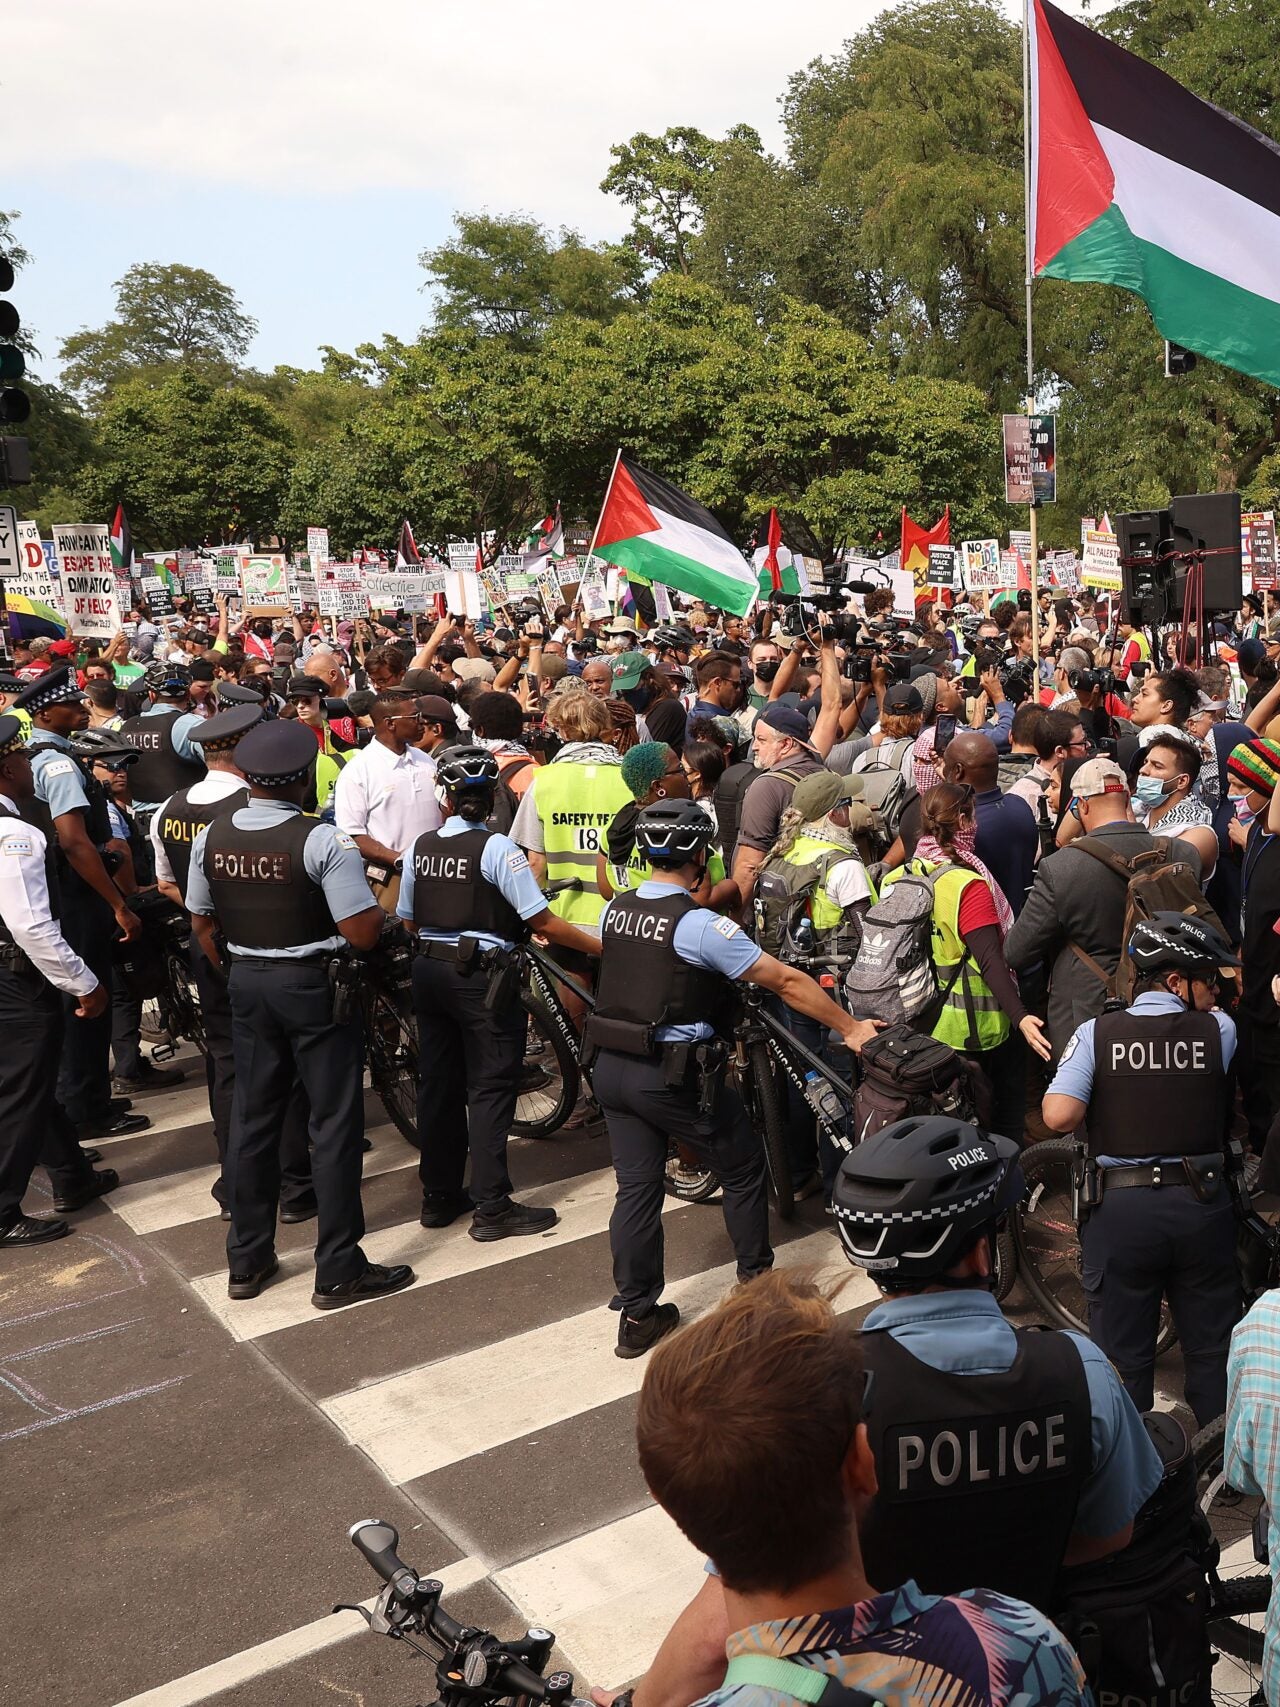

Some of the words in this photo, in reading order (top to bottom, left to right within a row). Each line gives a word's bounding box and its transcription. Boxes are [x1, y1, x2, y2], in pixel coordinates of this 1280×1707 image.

[1036, 433, 1048, 443] AID
[26, 528, 37, 538] OF
[59, 535, 78, 551] HOW
[97, 535, 110, 551] YE
[967, 543, 982, 553] NO
[97, 556, 113, 573] THE
[500, 556, 522, 566] VICTORY
[987, 564, 998, 573] IN
[35, 571, 49, 581] THE
[970, 570, 999, 586] APARTHEID
[40, 585, 52, 595] OF
[74, 598, 85, 613] OF
[85, 731, 103, 740] POLICE
[552, 812, 594, 826] SAFETY
[214, 852, 285, 882] POLICE
[415, 854, 468, 880] POLICE
[605, 909, 669, 941] POLICE
[1179, 921, 1207, 942] POLICE
[857, 954, 884, 965] adidas
[1111, 1040, 1206, 1070] POLICE
[768, 1038, 803, 1089] CHICAGO
[947, 1146, 990, 1172] POLICE
[898, 1413, 1067, 1491] POLICE
